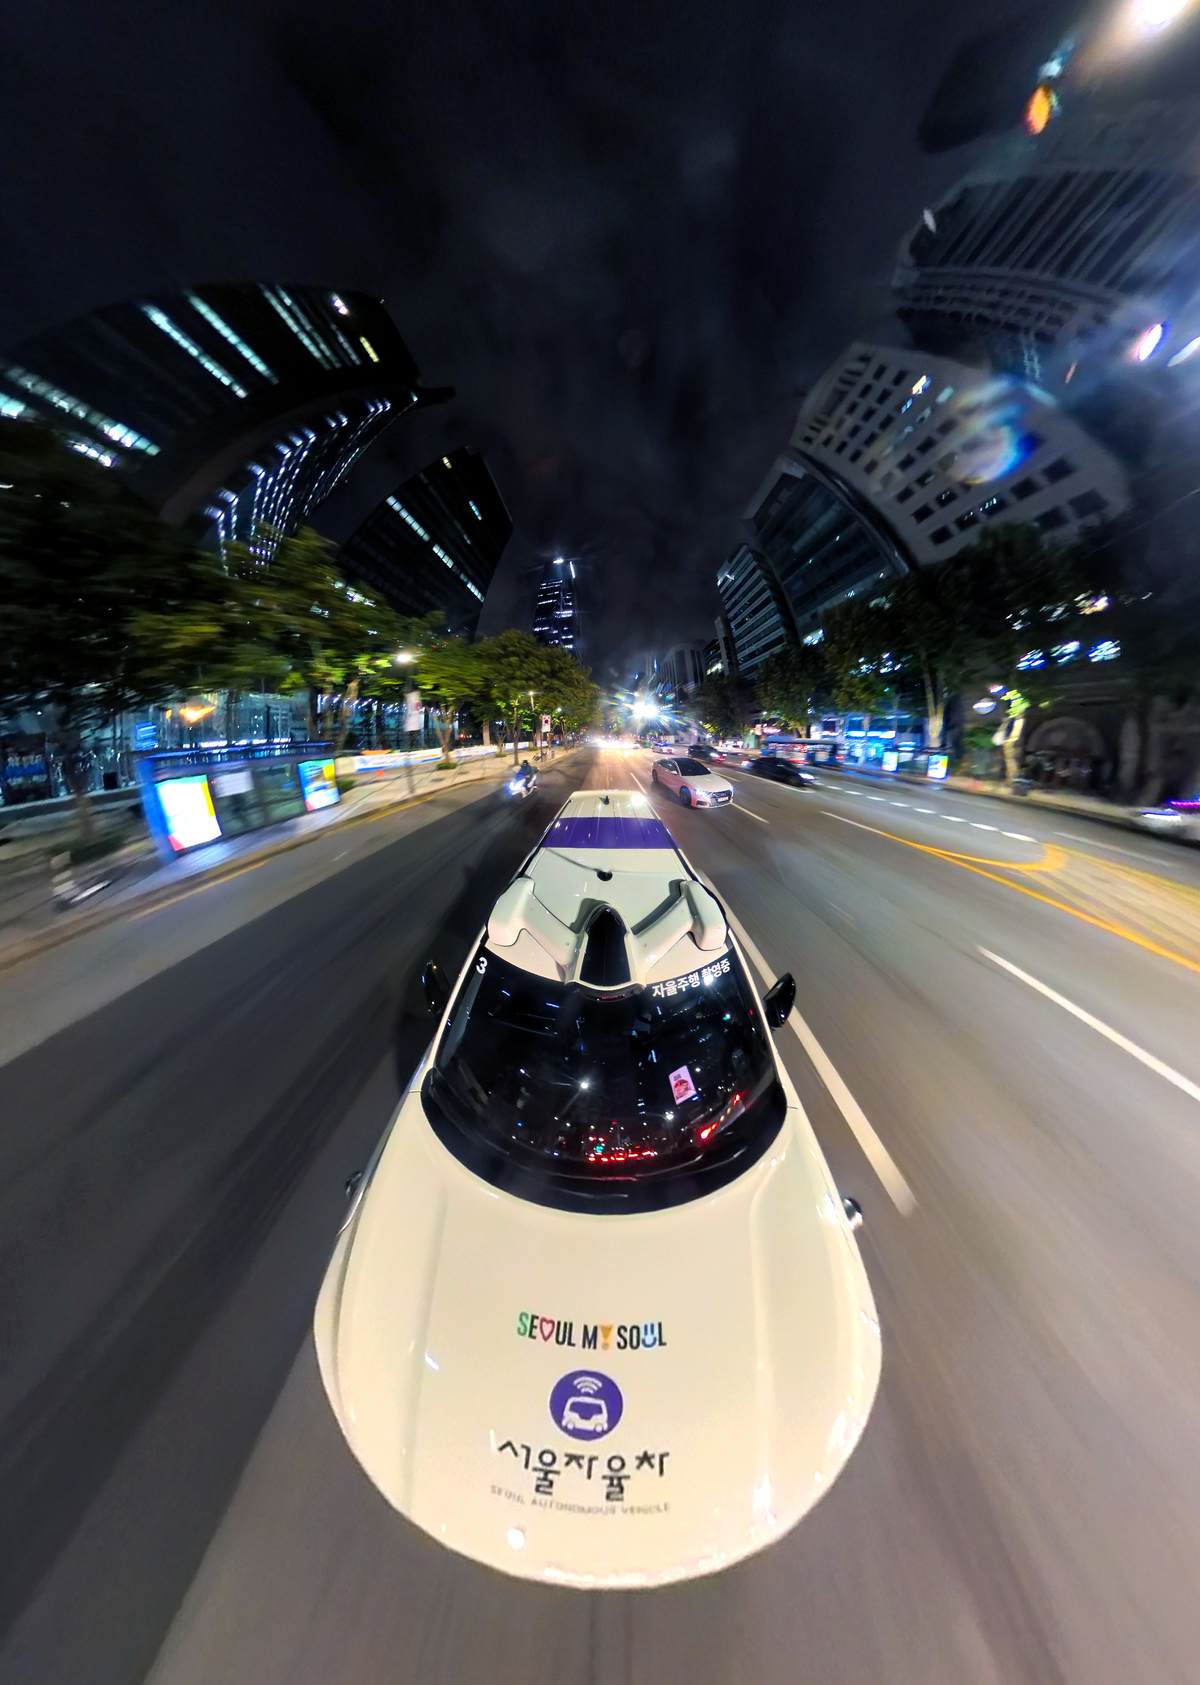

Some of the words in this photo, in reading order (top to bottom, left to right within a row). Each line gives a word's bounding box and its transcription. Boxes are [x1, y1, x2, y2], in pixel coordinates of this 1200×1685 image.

[476, 956, 488, 975] 3
[652, 971, 700, 998] 자율주행
[617, 1322, 667, 1350] SOUL
[498, 1440, 669, 1502] 서울자율차
